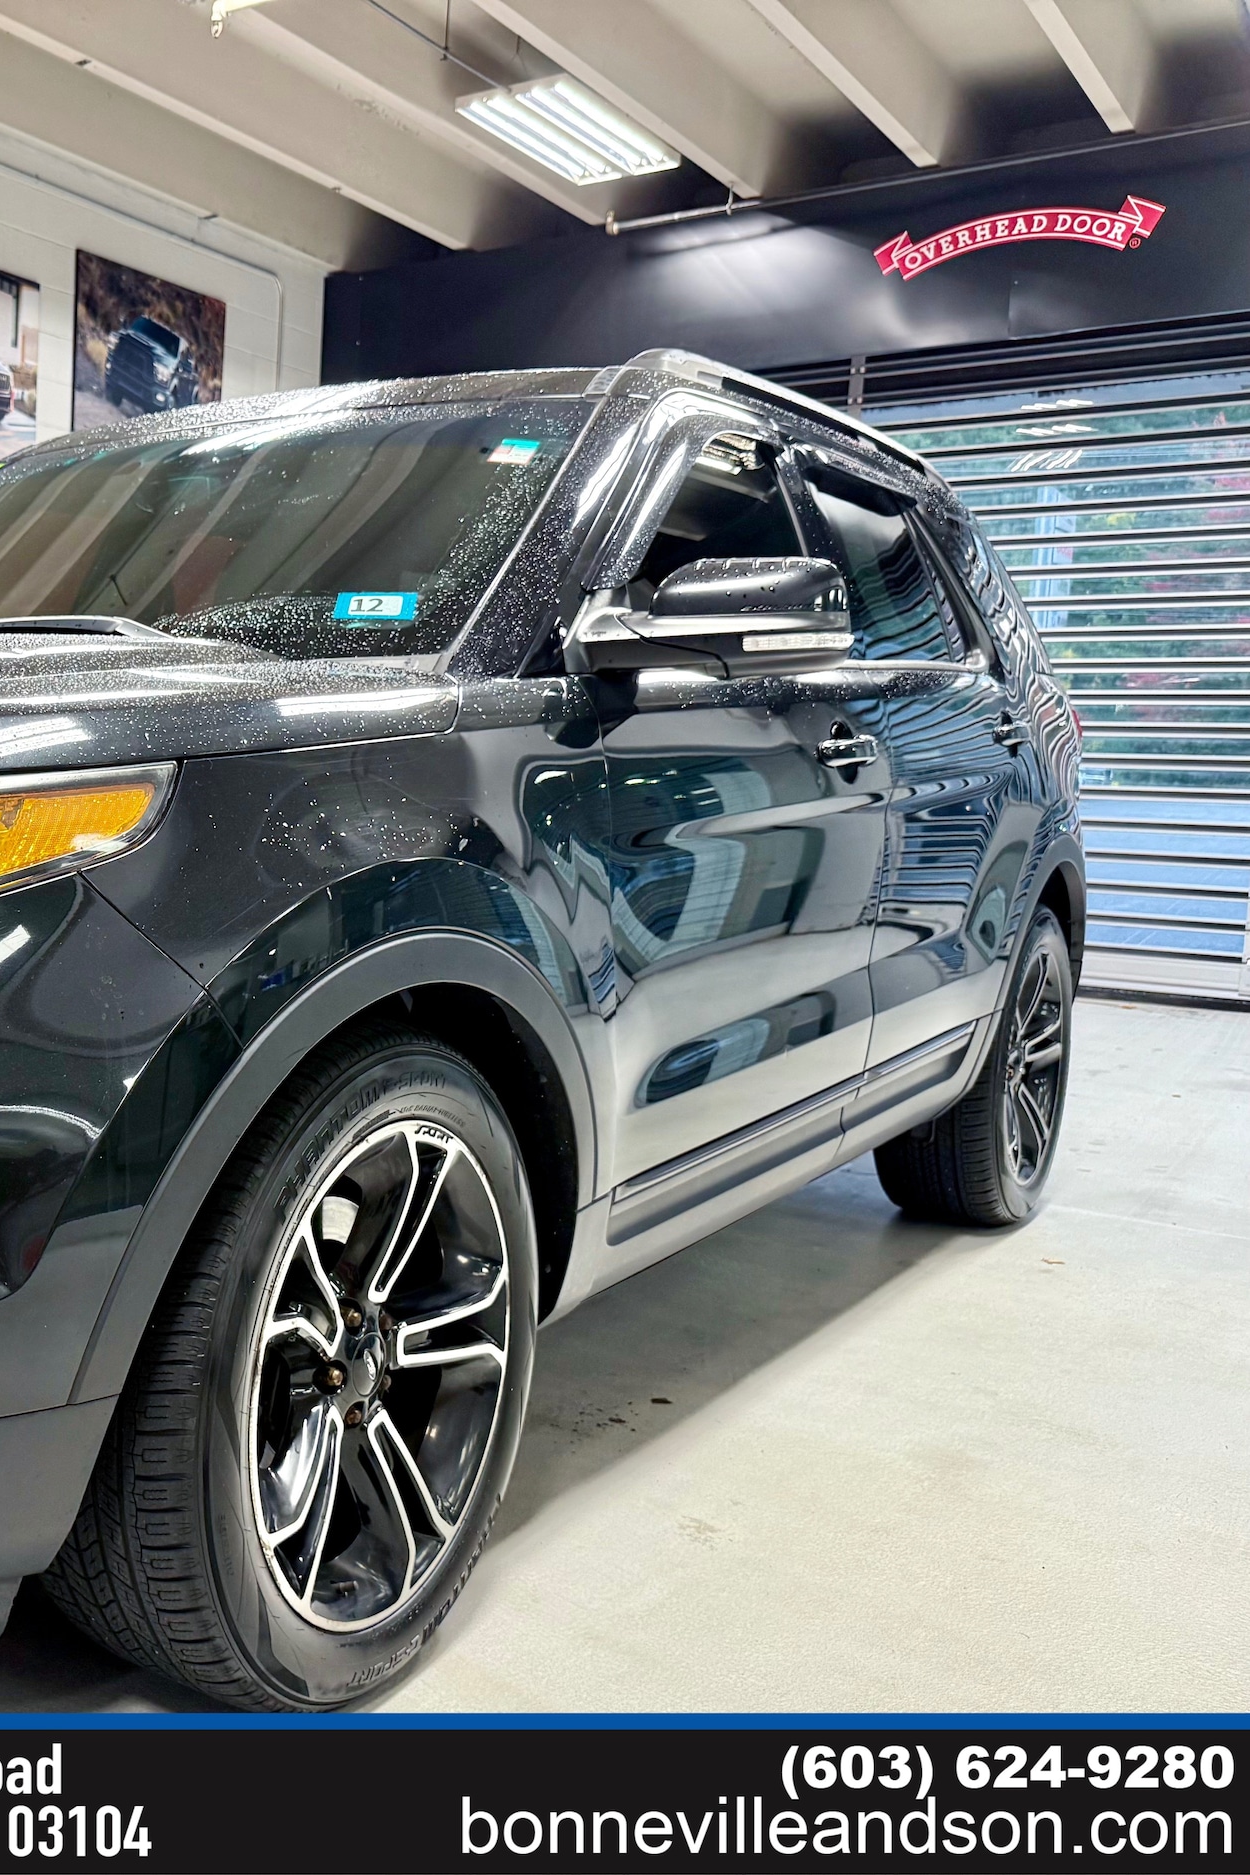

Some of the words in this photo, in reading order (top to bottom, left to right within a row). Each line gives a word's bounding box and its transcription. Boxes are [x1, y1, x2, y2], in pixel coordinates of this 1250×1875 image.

[904, 214, 1048, 270] OVERHEAD
[1054, 213, 1127, 241] DOOR
[350, 598, 384, 612] 12
